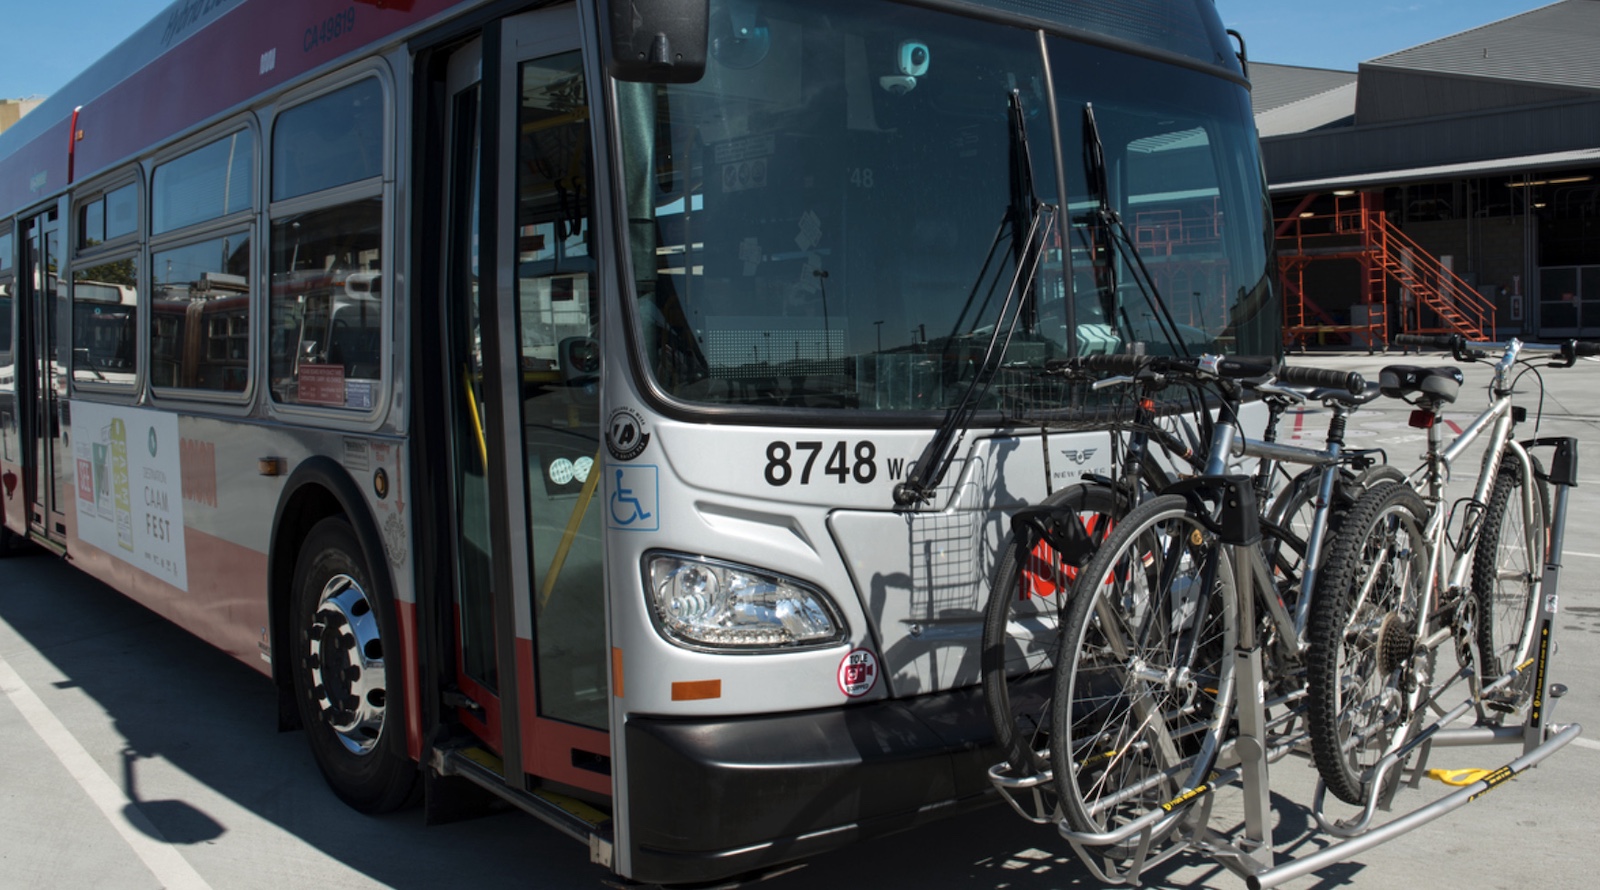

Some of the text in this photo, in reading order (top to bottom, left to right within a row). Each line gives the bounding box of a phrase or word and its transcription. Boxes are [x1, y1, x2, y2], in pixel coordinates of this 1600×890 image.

[764, 440, 904, 486] 8748 W
[1053, 471, 1075, 479] NEW
[144, 486, 169, 512] CAAM
[146, 513, 171, 543] FEST
